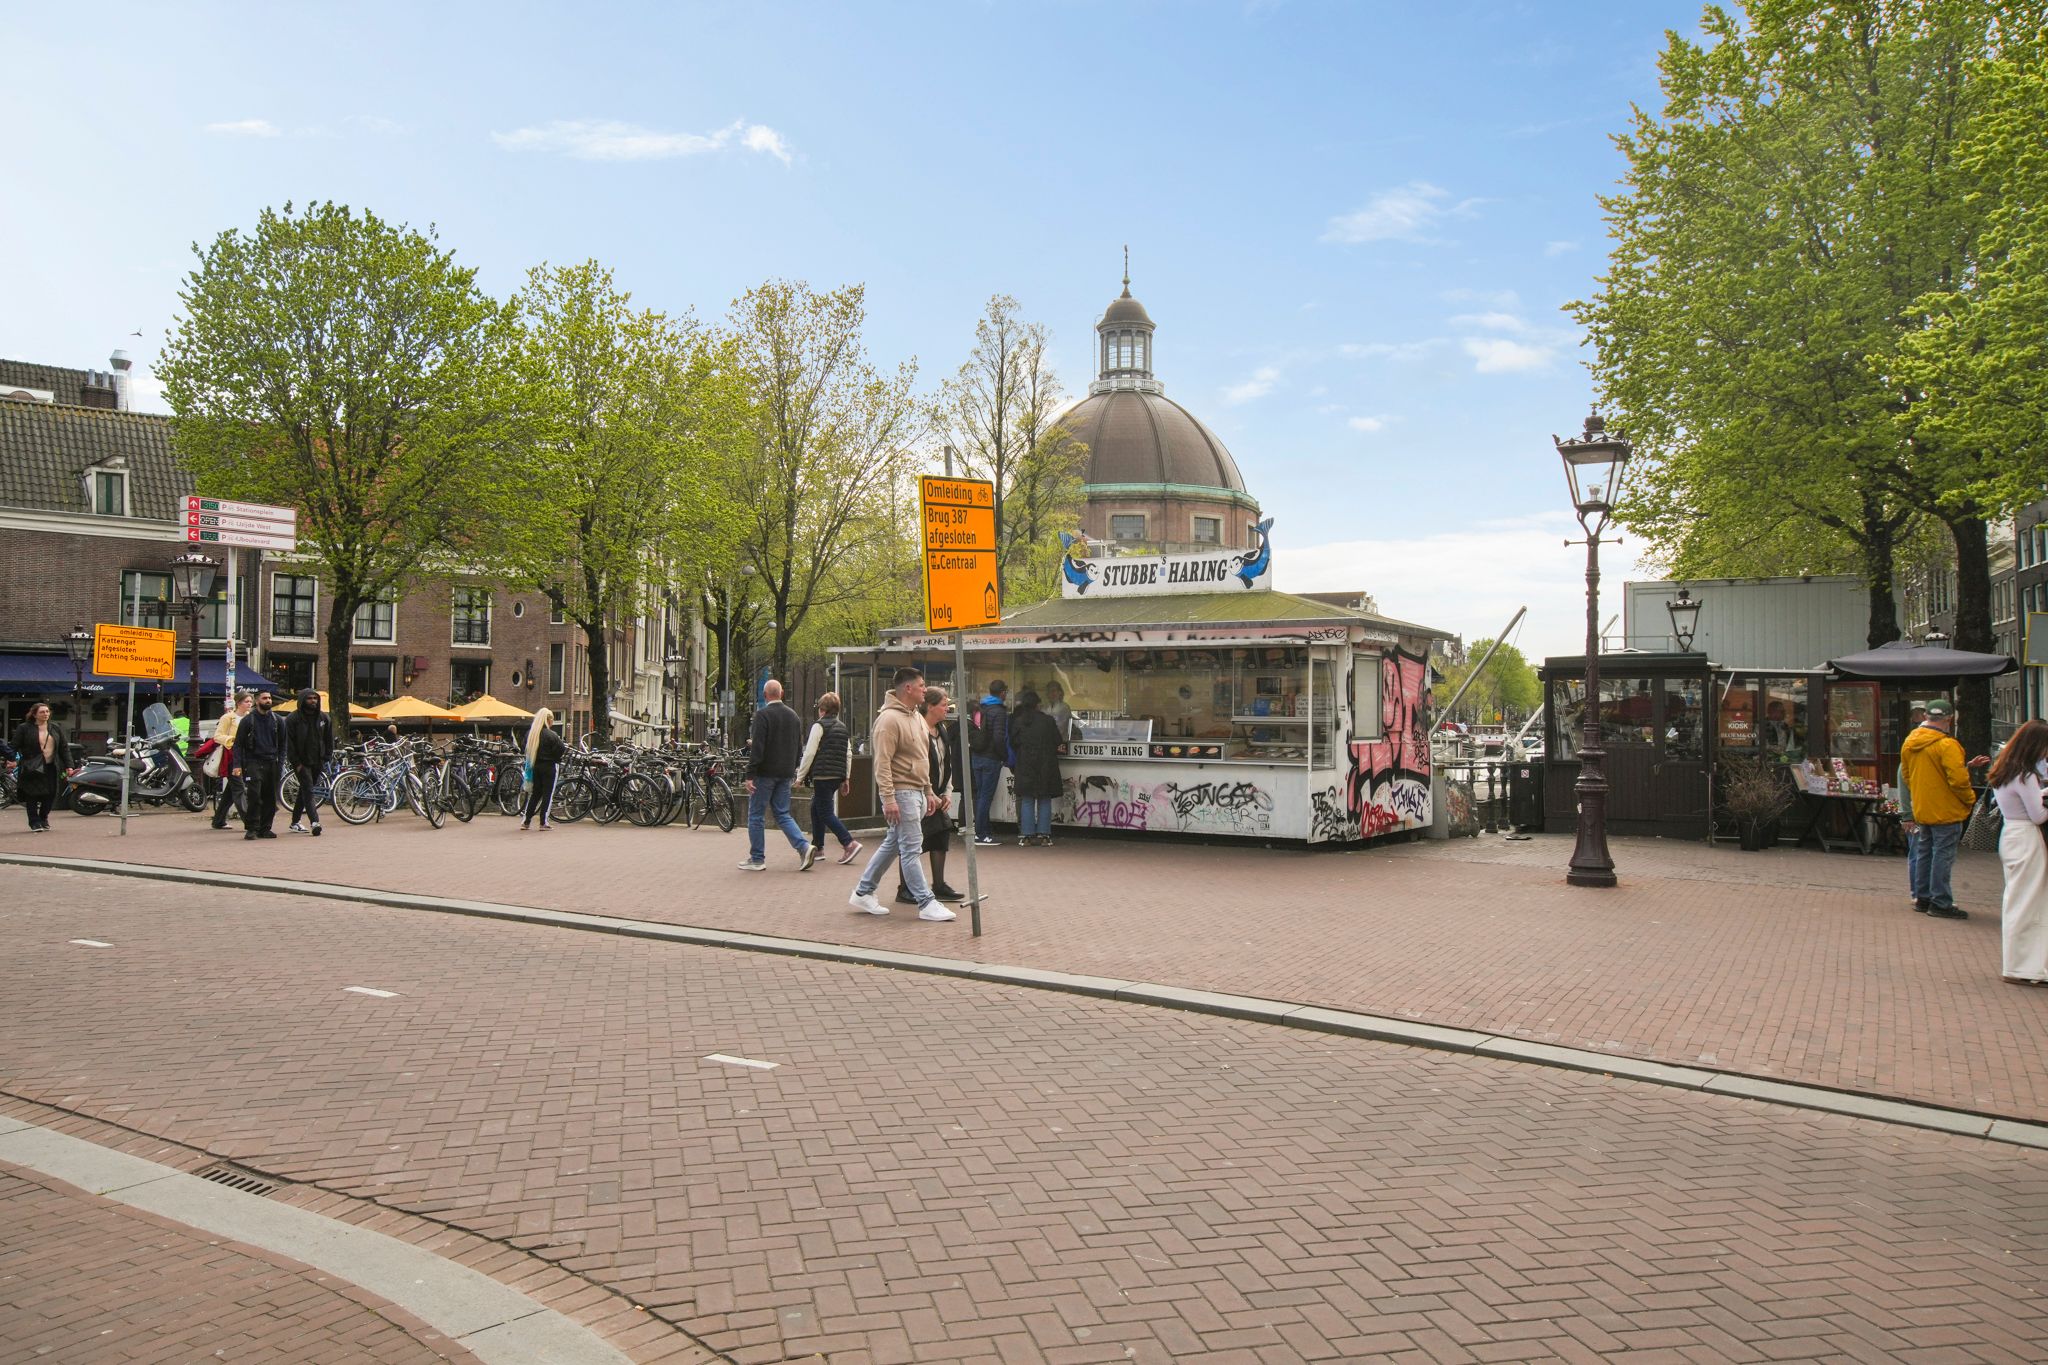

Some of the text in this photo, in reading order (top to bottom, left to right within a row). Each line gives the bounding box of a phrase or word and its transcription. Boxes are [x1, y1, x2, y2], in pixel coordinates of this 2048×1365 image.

[927, 482, 973, 504] Omleiding
[928, 508, 968, 527] Brug 387
[257, 523, 271, 531] West
[929, 528, 977, 548] afgesloten
[940, 555, 977, 570] Centraal
[1102, 563, 1158, 587] STUBBE
[1167, 559, 1228, 583] HARING
[932, 603, 953, 622] volg
[119, 629, 153, 638] omleiding
[101, 637, 136, 646] Kattengat
[101, 645, 137, 653] afgesloten
[100, 652, 164, 663] richting Spuistraat
[145, 667, 159, 675] volg
[1111, 746, 1143, 757] HARING
